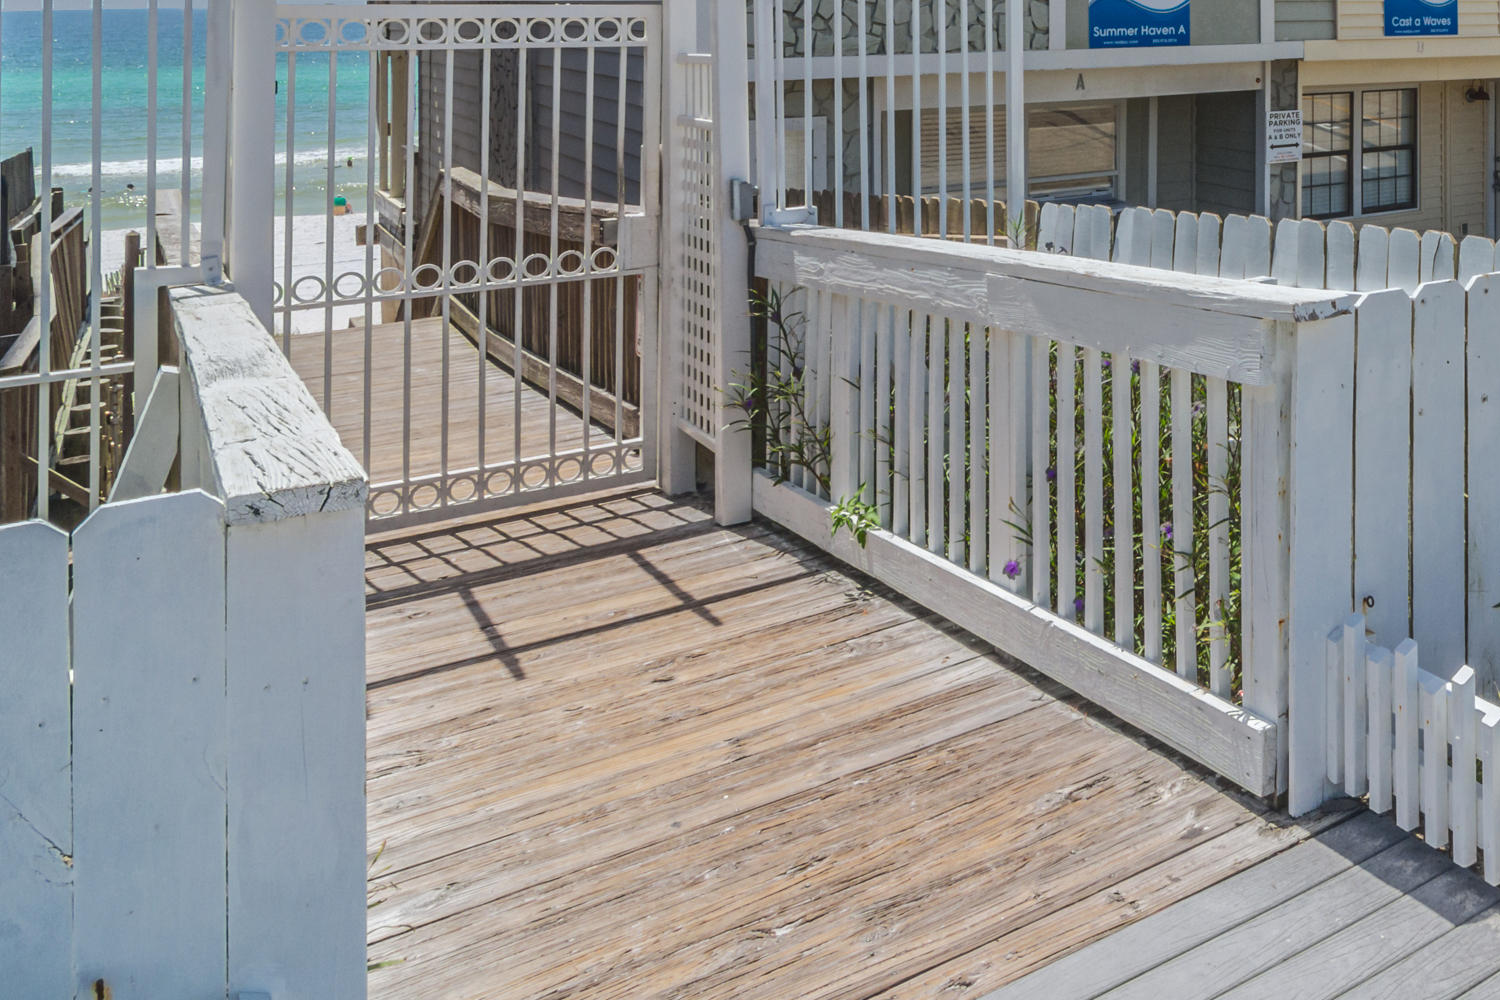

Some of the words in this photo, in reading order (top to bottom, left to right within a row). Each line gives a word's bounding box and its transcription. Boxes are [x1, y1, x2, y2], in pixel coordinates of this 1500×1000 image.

[1391, 16, 1412, 27] Cast
[1414, 18, 1421, 27] a
[1422, 15, 1452, 26] Waves
[1093, 25, 1138, 37] Summer
[1141, 25, 1175, 36] Haven
[1177, 24, 1186, 35] A
[1075, 72, 1086, 90] A
[1269, 112, 1300, 120] PRIVATE
